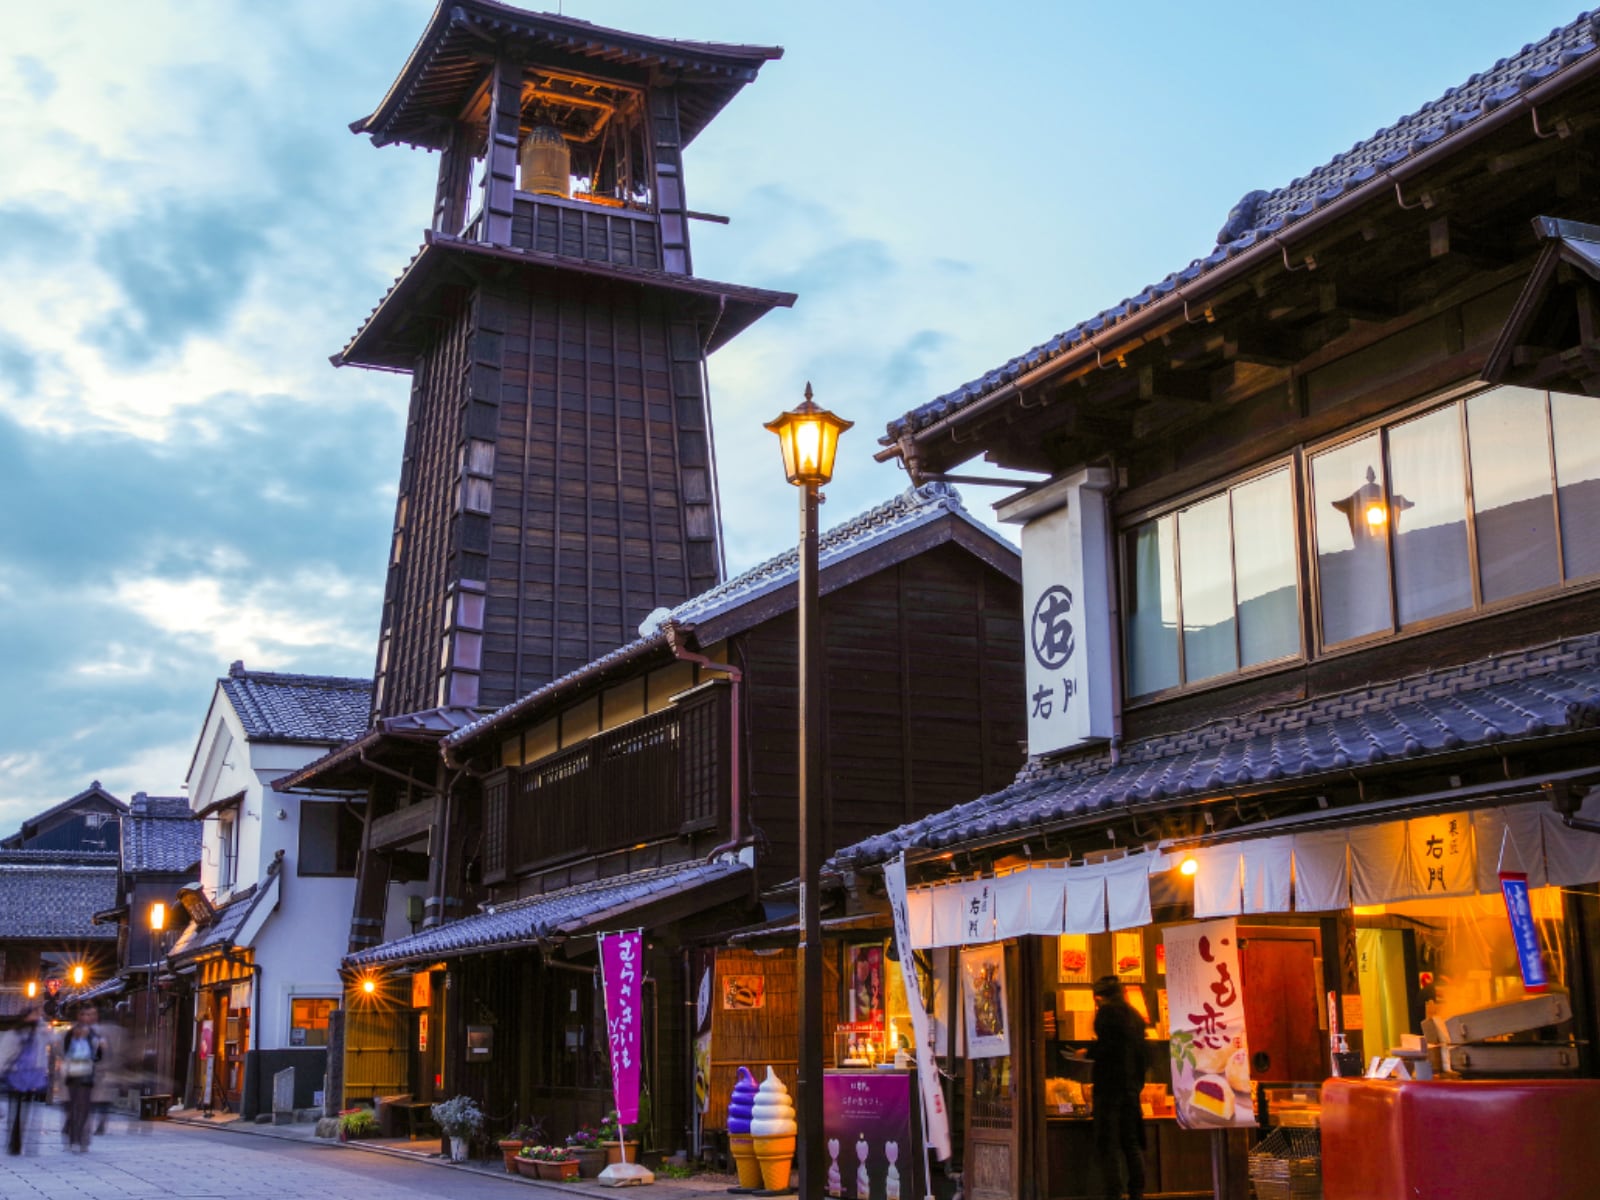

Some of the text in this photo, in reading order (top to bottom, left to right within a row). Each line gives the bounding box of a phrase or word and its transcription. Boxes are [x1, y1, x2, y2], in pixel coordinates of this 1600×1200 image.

[1425, 834, 1447, 891] 右門
[968, 896, 981, 937] 右門
[618, 936, 640, 1070] むらさきいも
[1187, 934, 1238, 1051] いも恋
